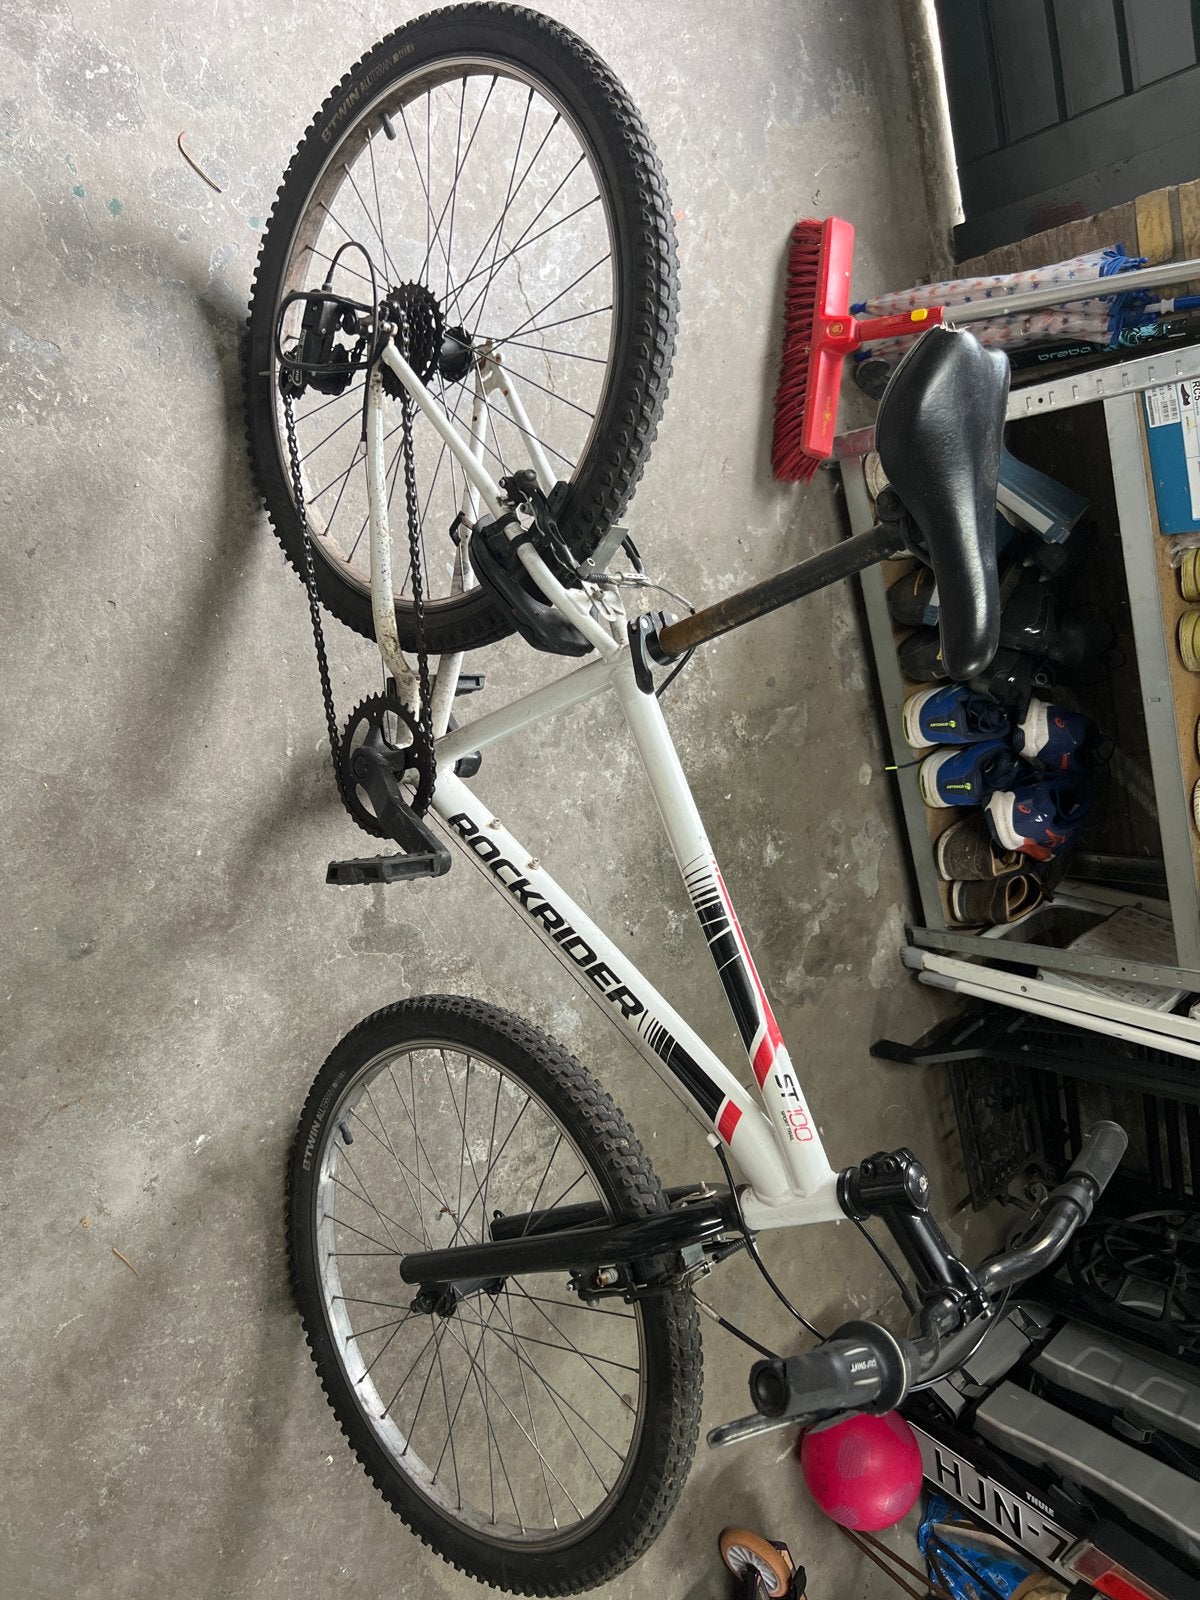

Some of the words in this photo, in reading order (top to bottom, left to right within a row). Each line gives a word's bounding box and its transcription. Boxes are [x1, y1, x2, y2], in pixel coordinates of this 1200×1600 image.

[1038, 346, 1091, 362] brabo
[446, 812, 646, 1021] ROCKRIDER
[774, 1074, 799, 1102] ST
[786, 1105, 813, 1142] 100
[1025, 1491, 1055, 1518] THULE
